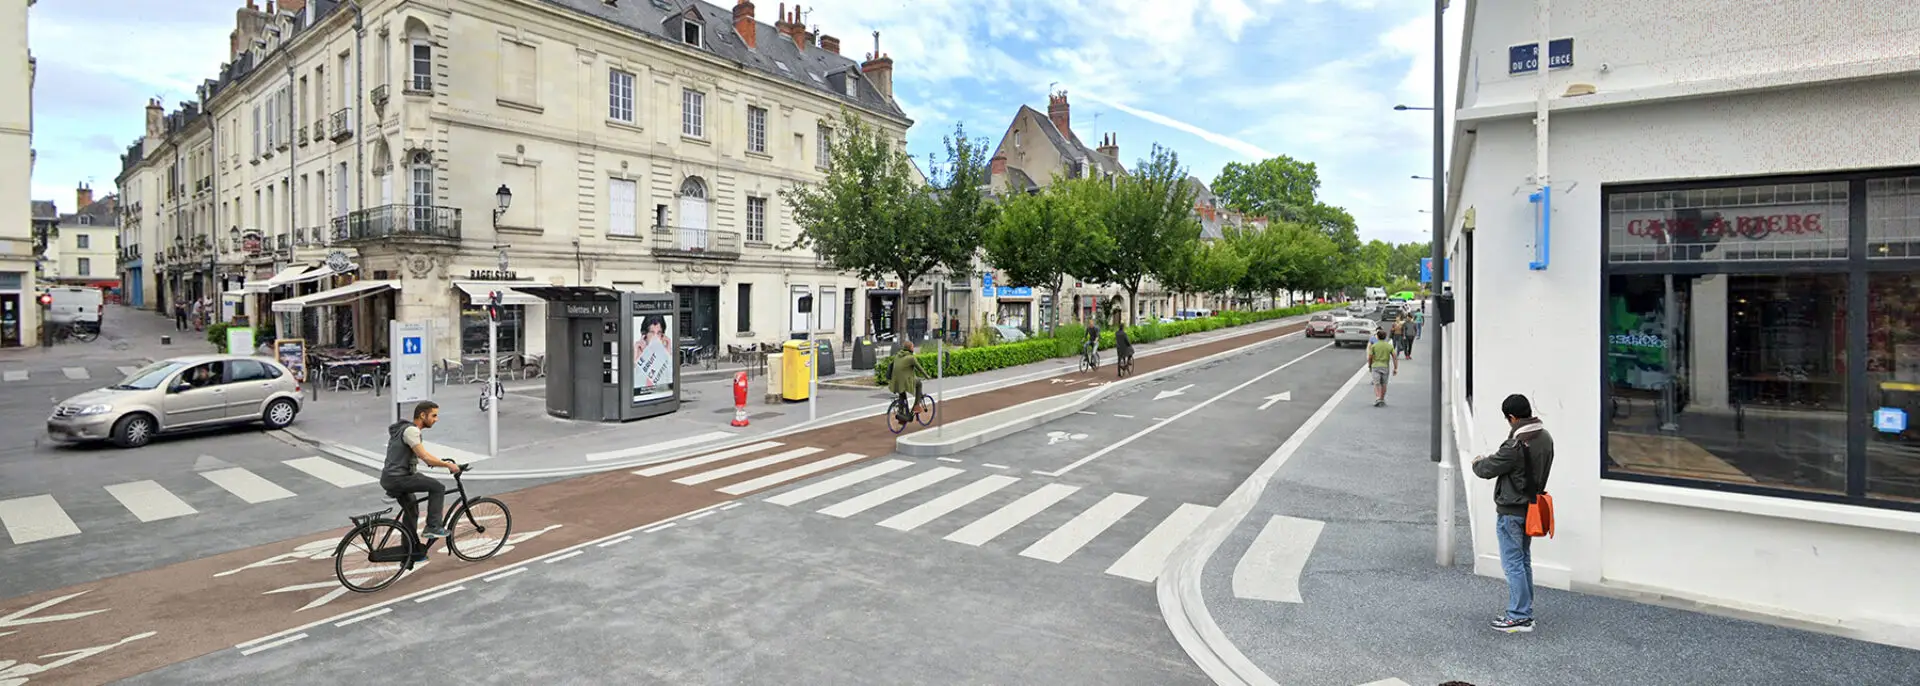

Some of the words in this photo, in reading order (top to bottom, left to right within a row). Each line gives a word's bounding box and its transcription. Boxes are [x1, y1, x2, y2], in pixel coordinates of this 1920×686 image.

[1512, 61, 1523, 70] DU
[1526, 54, 1571, 68] COERCE
[470, 270, 517, 280] BAGELSTEIN
[567, 305, 590, 314] Toilettes
[637, 357, 645, 366] LE
[643, 352, 657, 372] BRUIT
